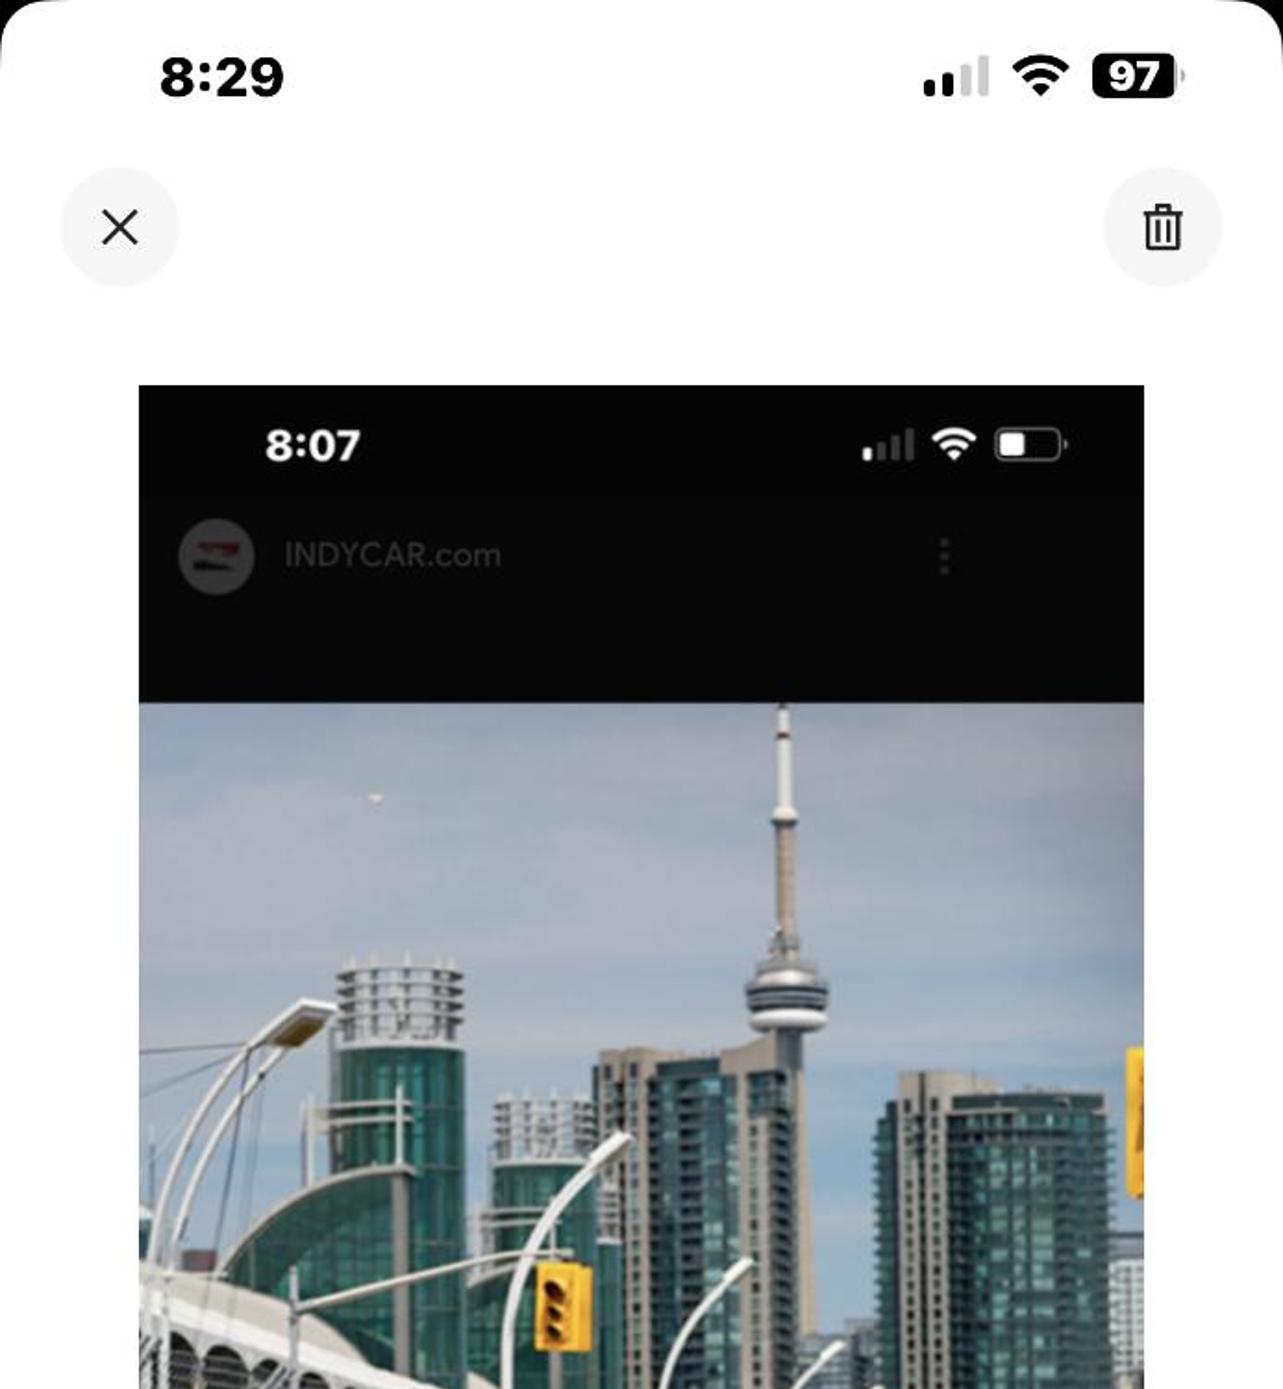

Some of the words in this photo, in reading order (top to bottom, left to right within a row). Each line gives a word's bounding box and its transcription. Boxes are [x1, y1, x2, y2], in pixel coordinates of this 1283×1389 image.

[160, 56, 285, 98] 8:29
[1108, 60, 1160, 92] 97
[265, 428, 362, 463] 8:07
[285, 541, 501, 568] INDYCAR.com
